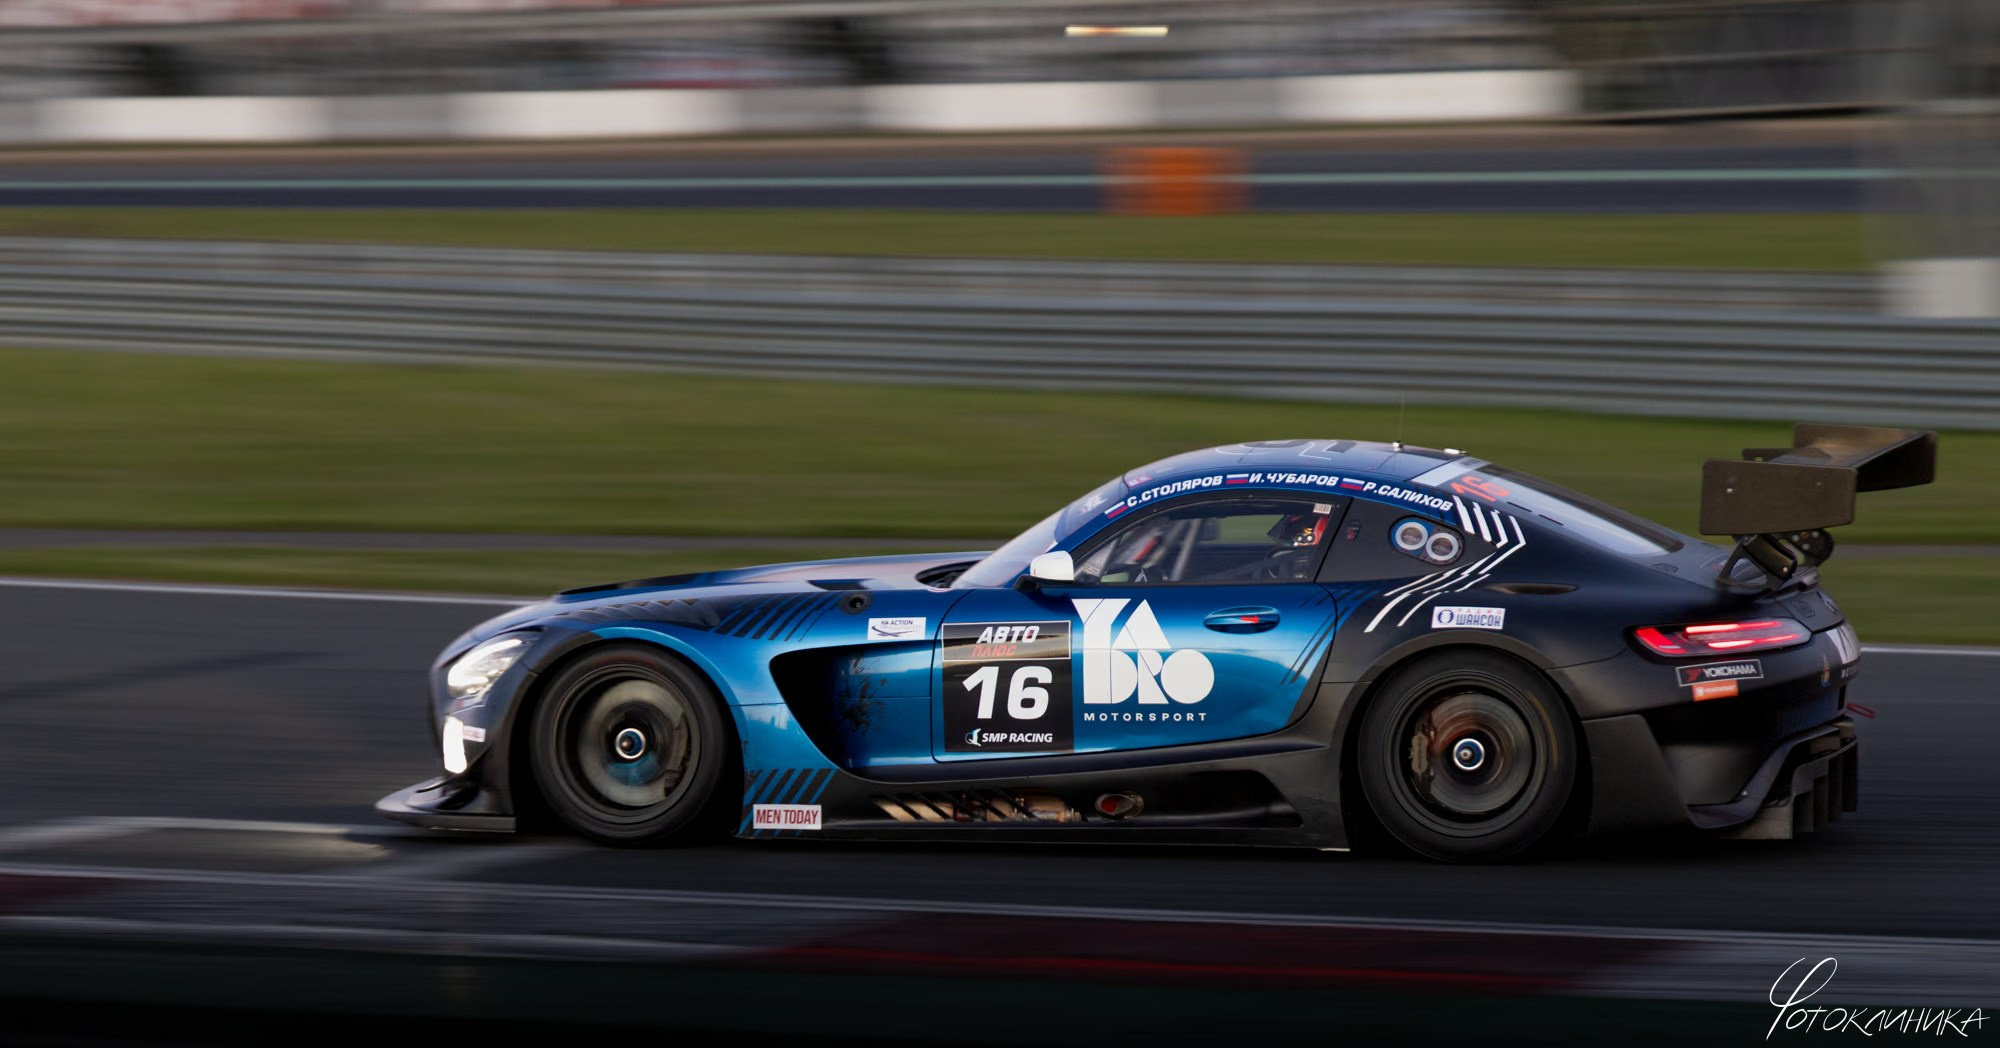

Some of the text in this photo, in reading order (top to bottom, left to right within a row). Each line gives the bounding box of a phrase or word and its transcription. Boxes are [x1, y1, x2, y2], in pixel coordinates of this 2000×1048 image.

[1248, 473, 1339, 487] И.ЧУБАРОВ
[1127, 475, 1223, 507] С.СТОЛЯРОВ
[1362, 481, 1454, 511] Р.САЛИХОВ
[1456, 614, 1502, 627] ШАНСОН
[976, 625, 1040, 644] АВТО
[1701, 664, 1758, 678] YOKOHAMA
[961, 665, 1053, 720] 16
[1083, 712, 1207, 722] MOTORSPORT
[981, 732, 1053, 743] SMP RACING
[756, 809, 819, 825] MEN TODAY
